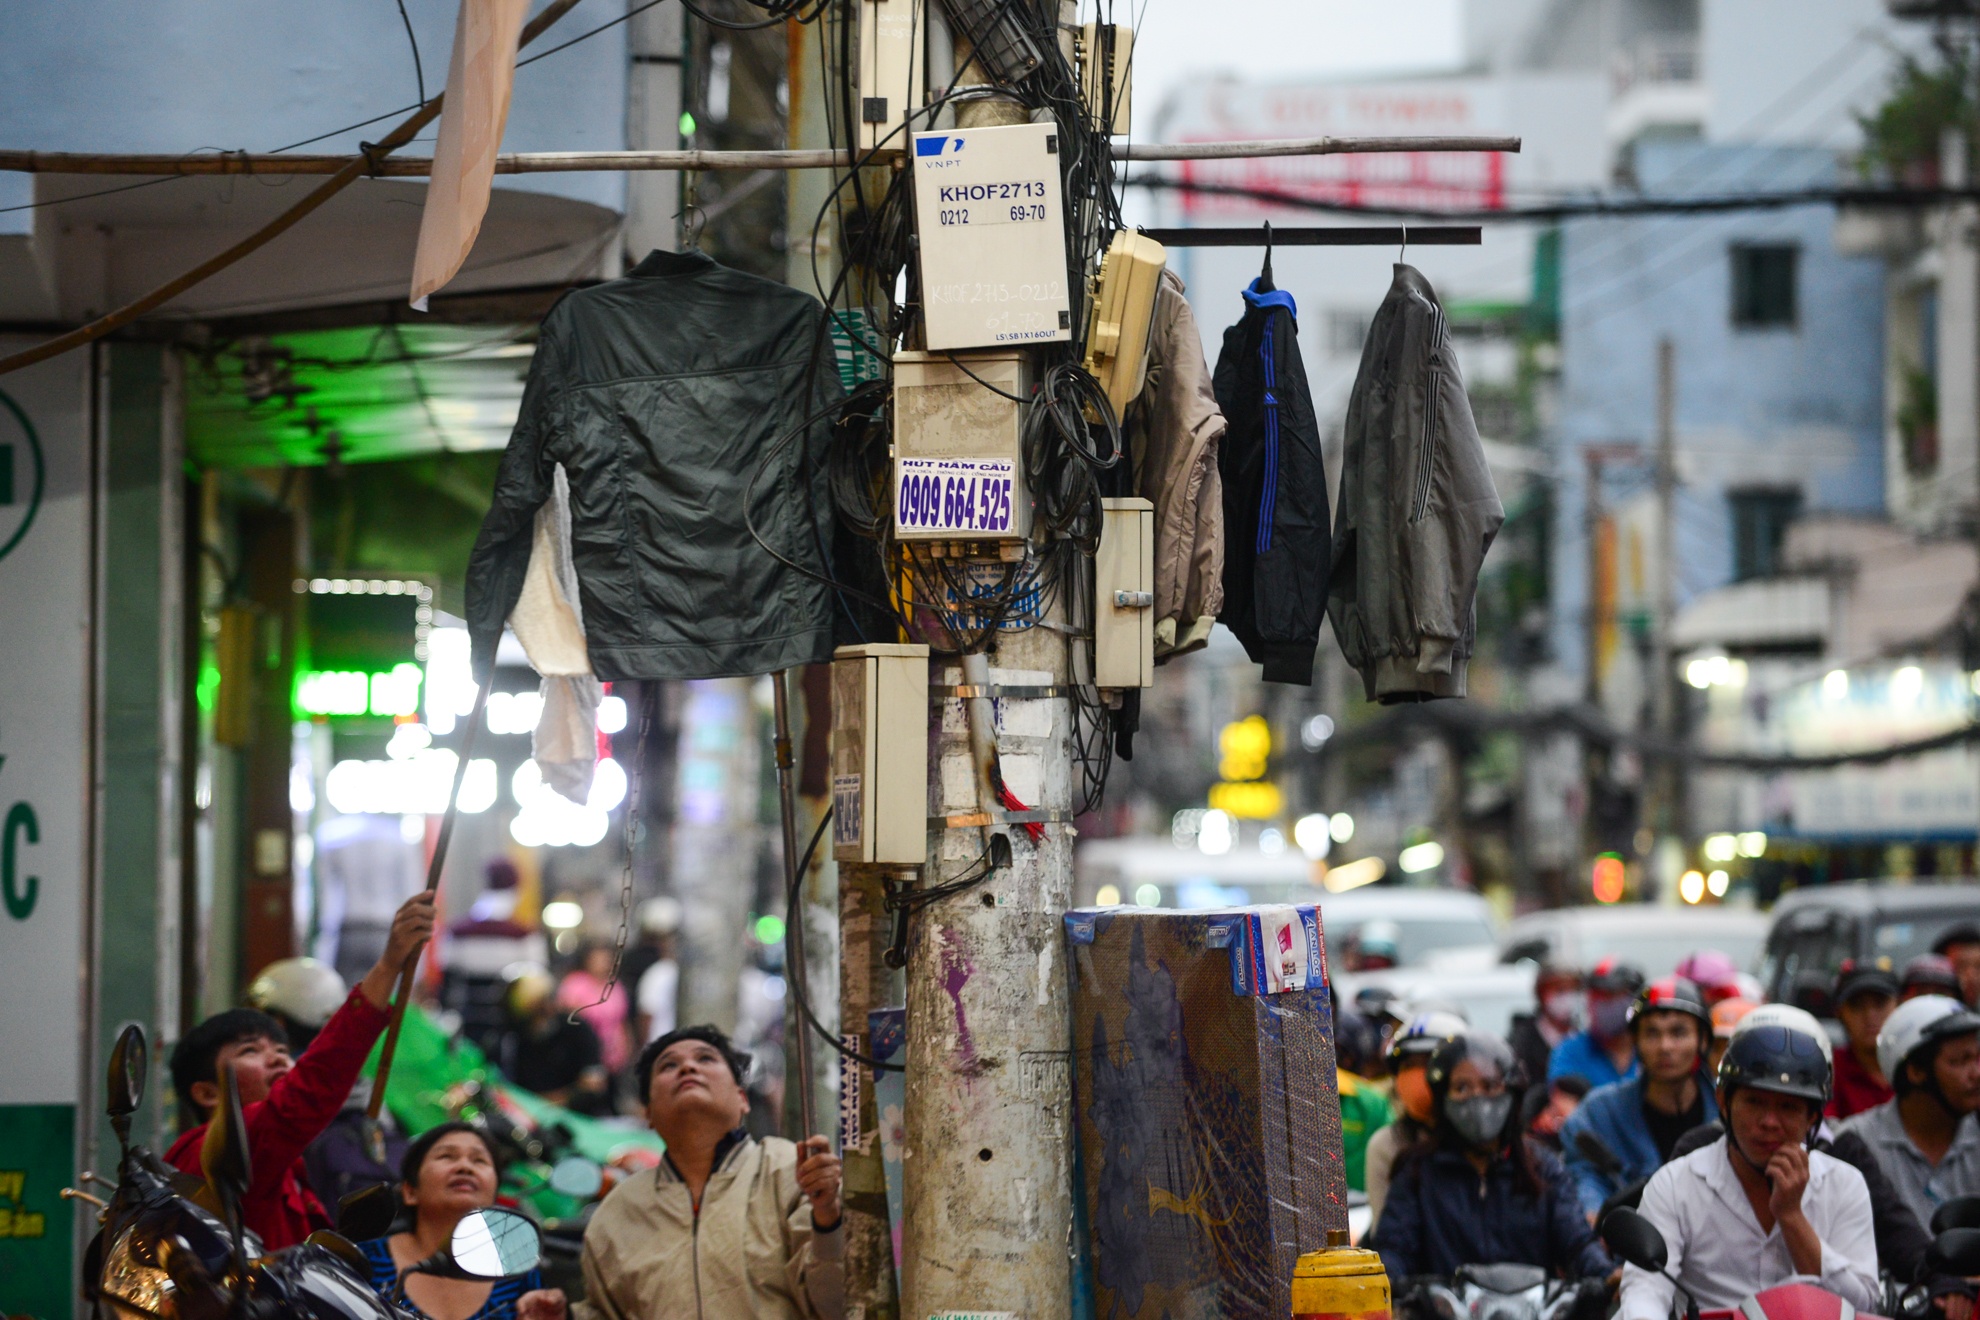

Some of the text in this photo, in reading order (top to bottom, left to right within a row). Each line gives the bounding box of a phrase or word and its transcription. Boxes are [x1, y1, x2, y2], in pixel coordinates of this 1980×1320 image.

[926, 160, 961, 169] VNPT
[940, 182, 1045, 203] KHOF2713
[940, 204, 1045, 225] 0212 69-70
[903, 459, 935, 468] HÚT
[899, 474, 1011, 531] 0909.664.525
